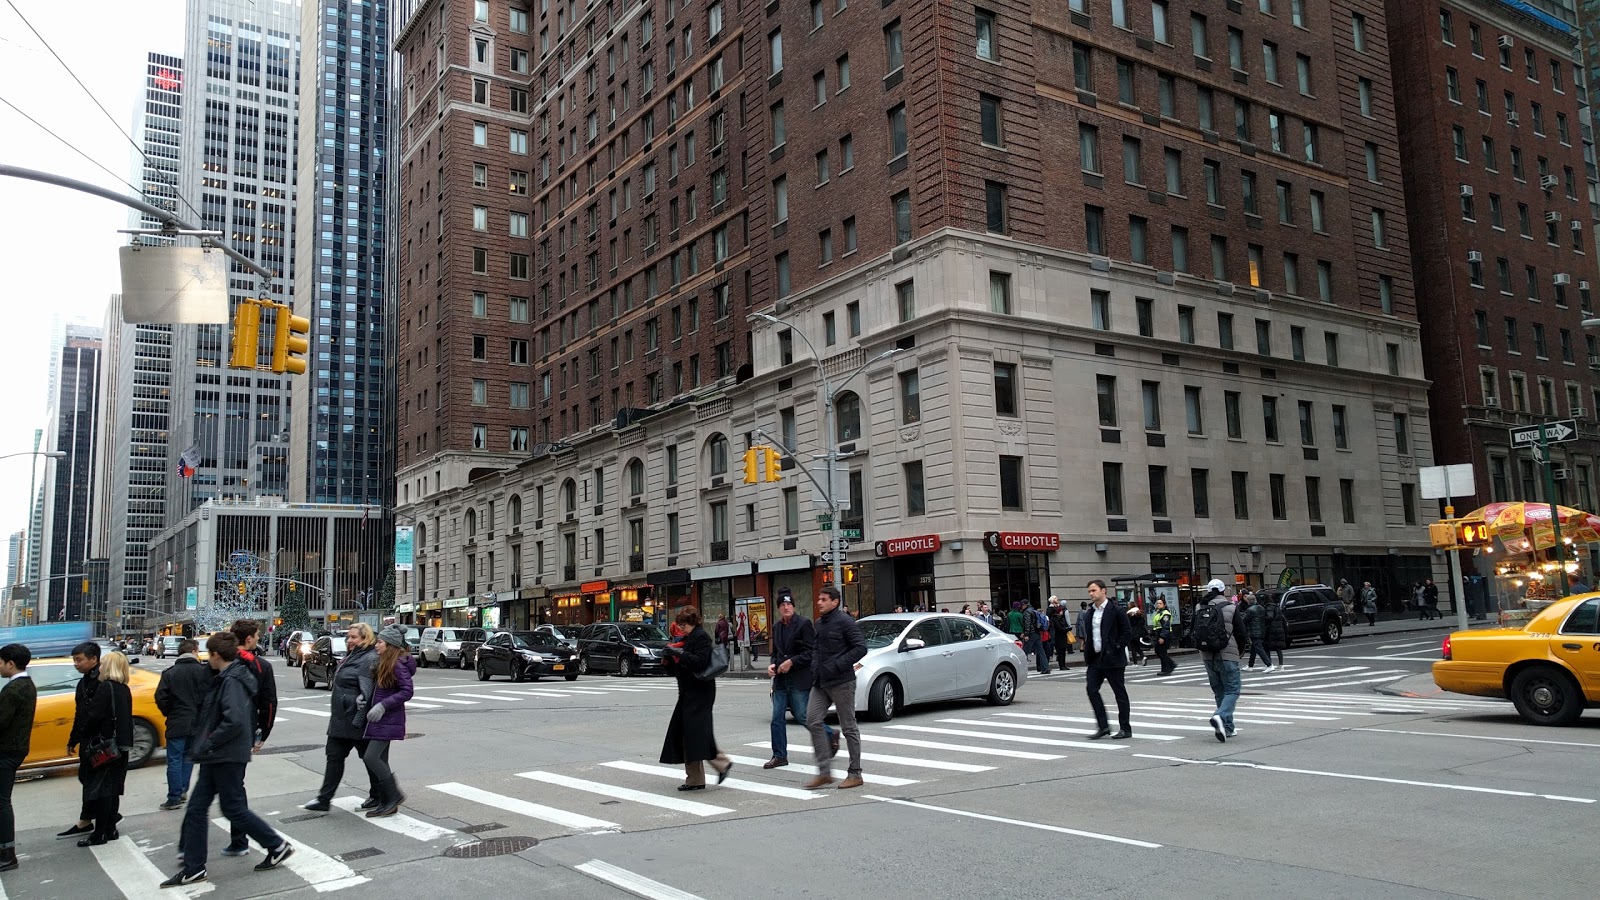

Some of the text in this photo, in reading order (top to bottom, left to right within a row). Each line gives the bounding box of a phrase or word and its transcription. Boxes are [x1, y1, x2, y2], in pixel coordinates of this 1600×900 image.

[1520, 427, 1566, 441] ONE WAY
[888, 538, 934, 552] CHIPOTLE
[1005, 535, 1057, 546] CHIPOTLE
